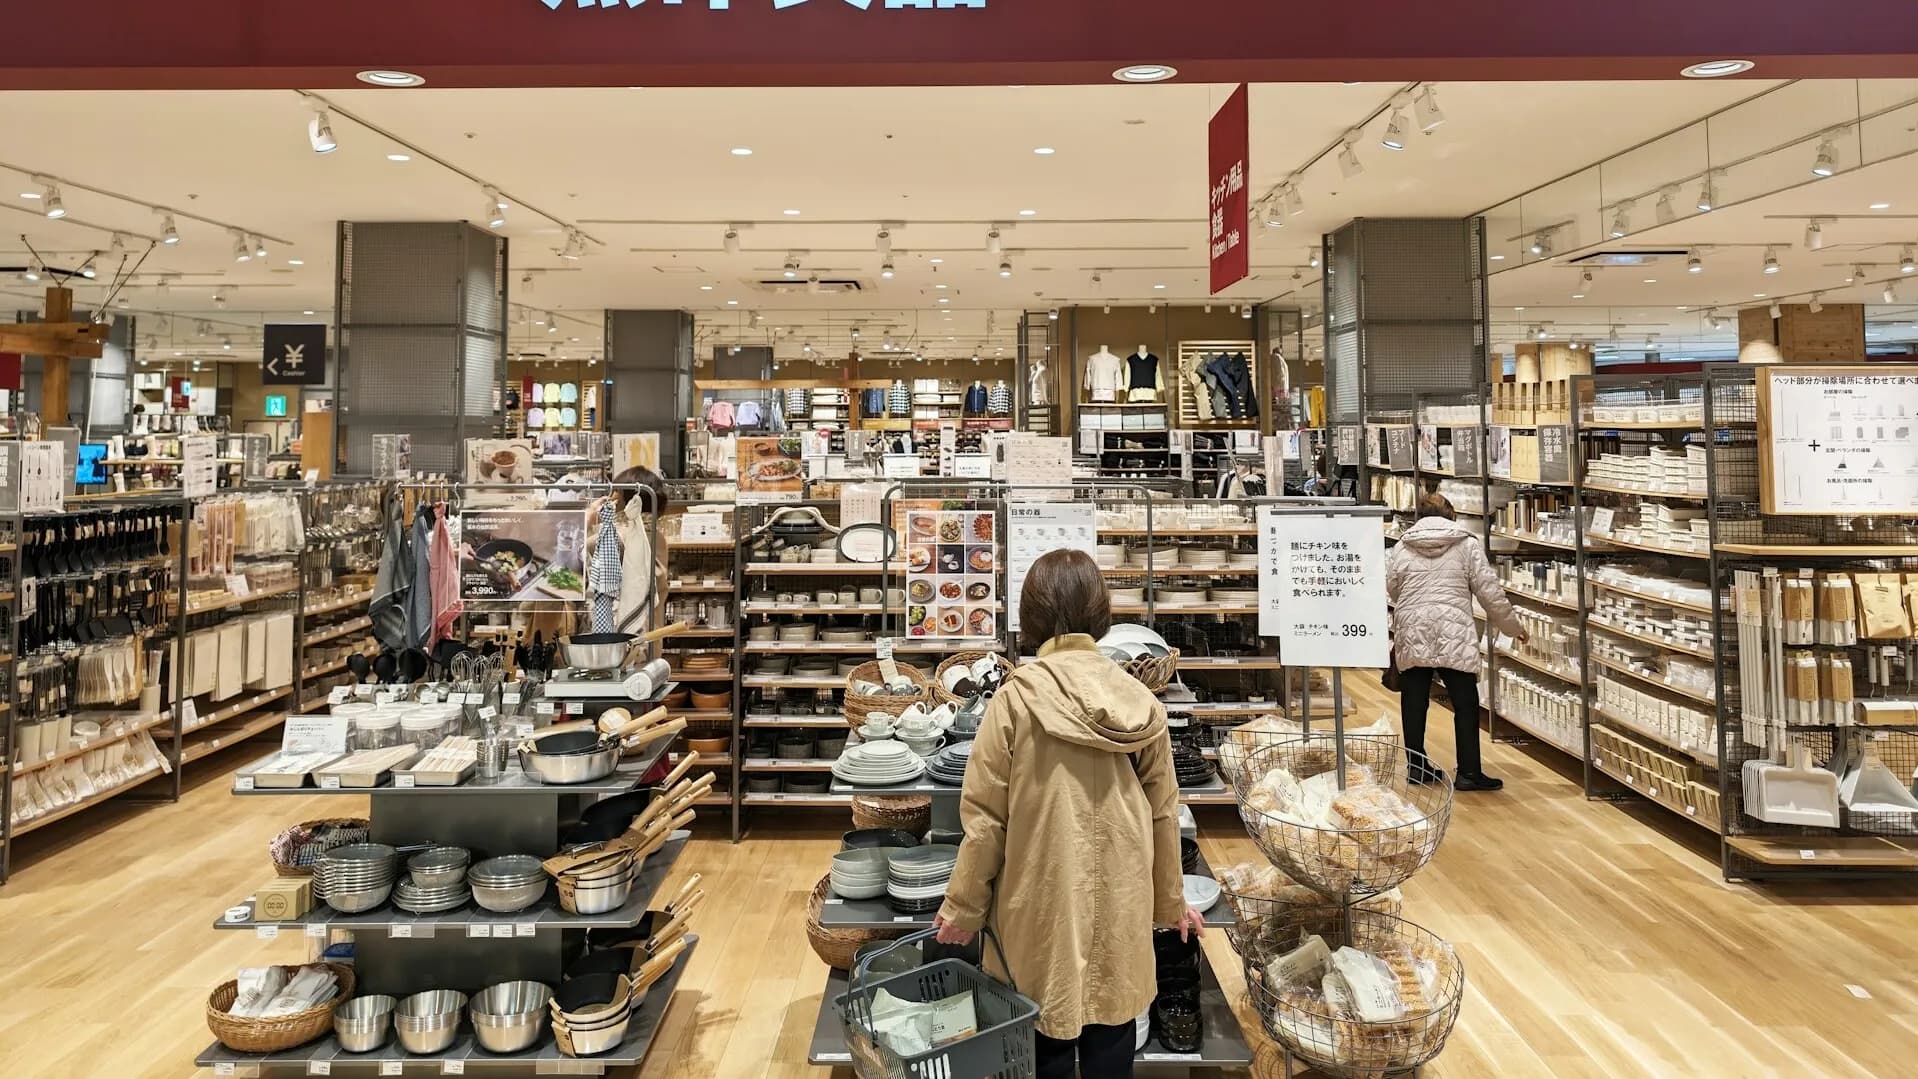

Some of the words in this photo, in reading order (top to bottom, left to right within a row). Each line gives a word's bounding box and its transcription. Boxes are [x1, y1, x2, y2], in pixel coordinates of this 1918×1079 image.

[1211, 159, 1243, 209] キッチン用品
[1293, 588, 1346, 598] 食べられます。
[1342, 624, 1367, 637] 399
